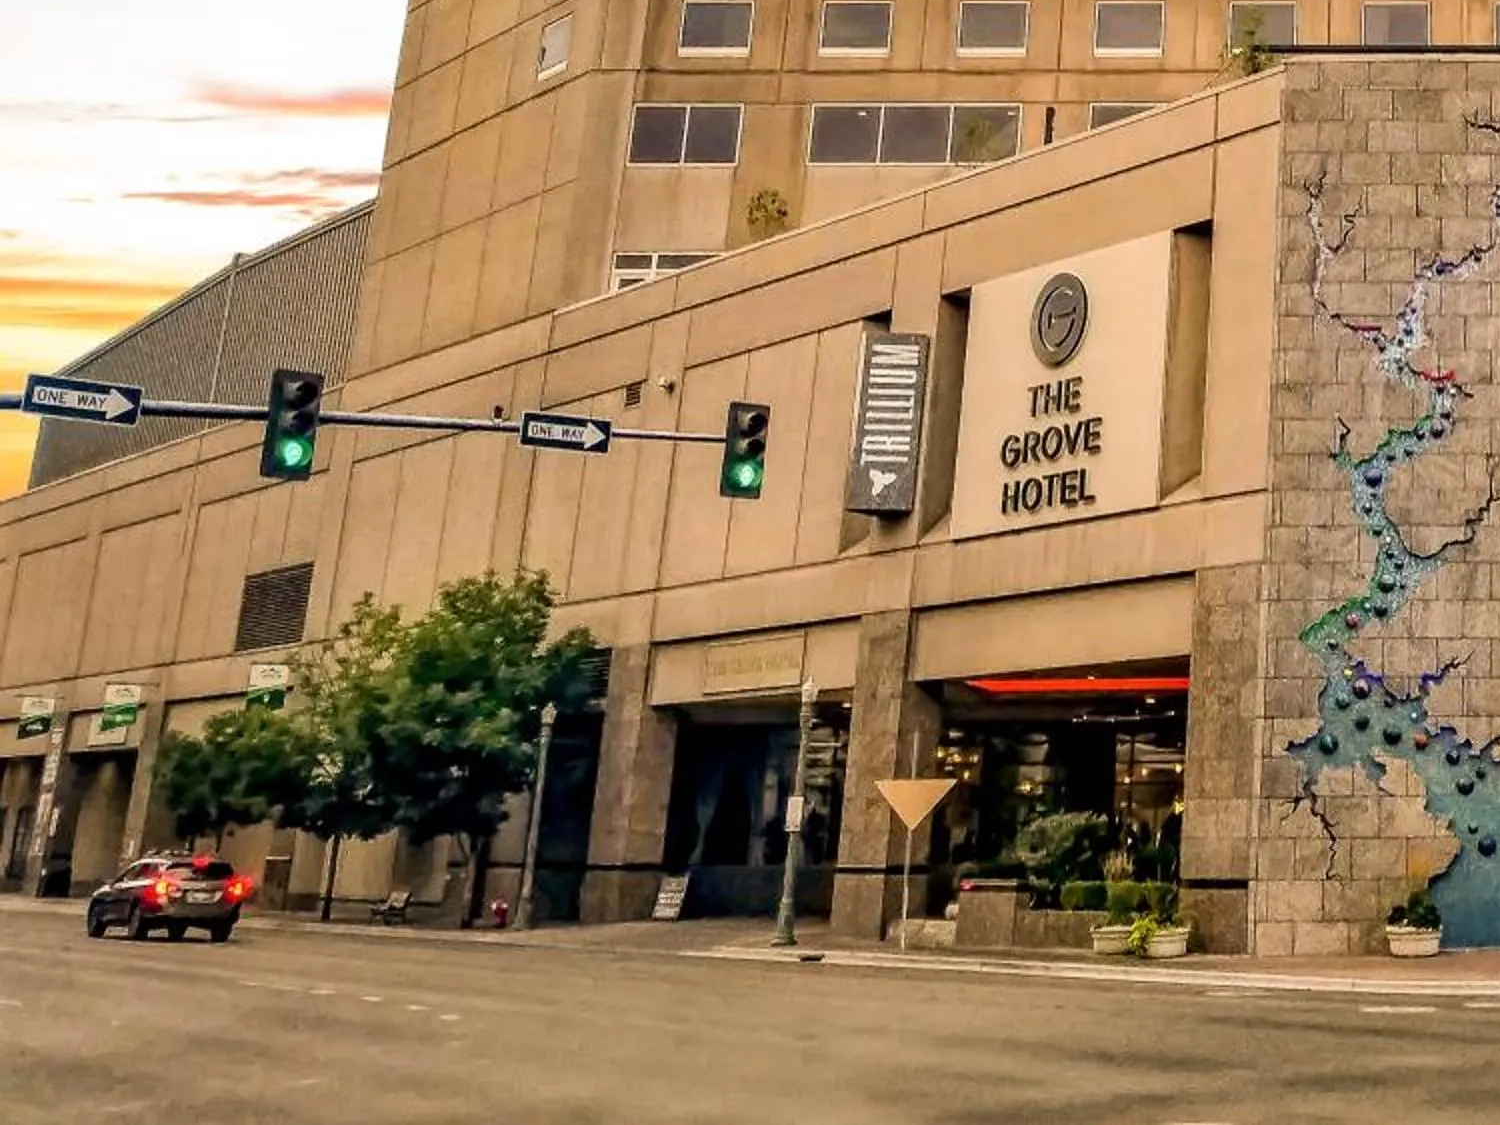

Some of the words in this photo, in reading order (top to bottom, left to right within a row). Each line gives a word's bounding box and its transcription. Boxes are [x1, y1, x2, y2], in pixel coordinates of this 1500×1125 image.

[36, 388, 67, 404] ONE
[77, 393, 107, 408] WAY
[860, 344, 921, 470] TRILLIUM
[1028, 376, 1083, 418] THE
[532, 424, 552, 438] ONE
[561, 427, 585, 441] WAY
[1001, 416, 1103, 469] GROVE
[1001, 468, 1096, 515] HOTEL
